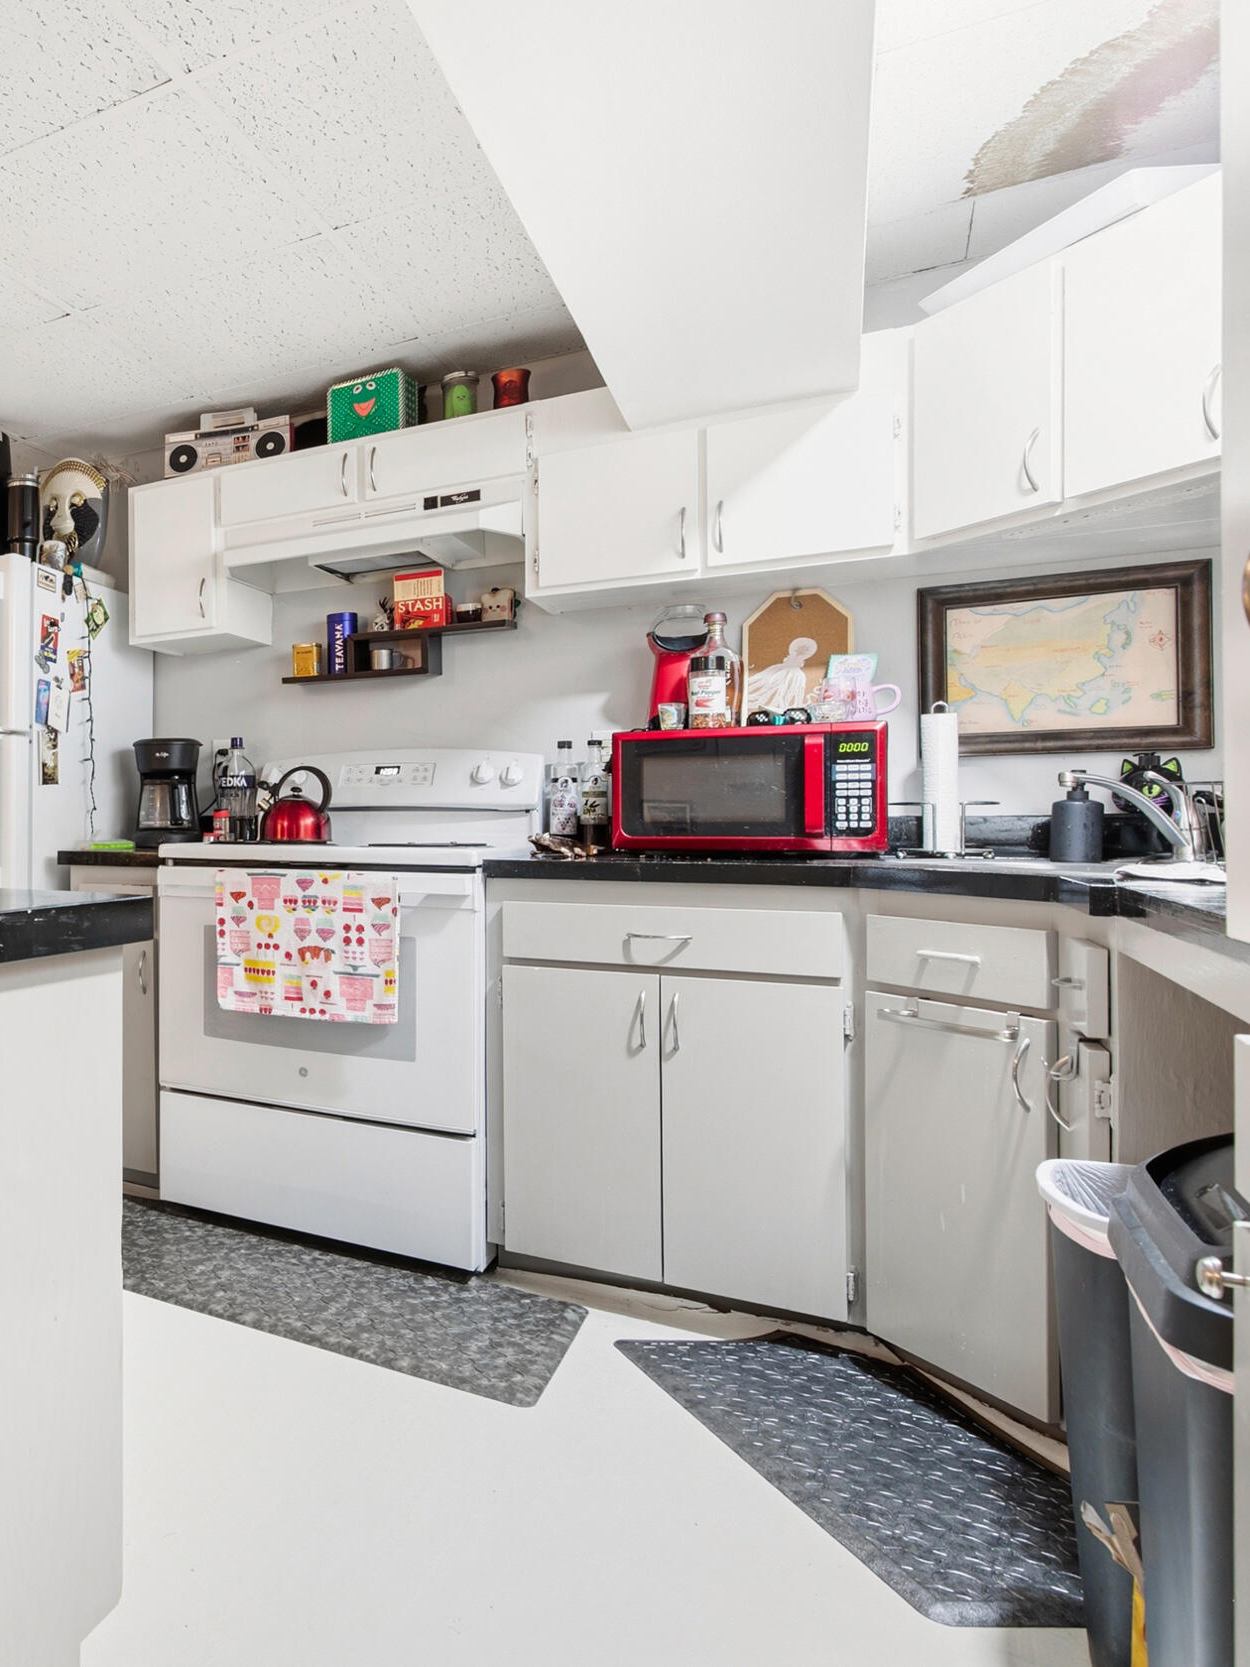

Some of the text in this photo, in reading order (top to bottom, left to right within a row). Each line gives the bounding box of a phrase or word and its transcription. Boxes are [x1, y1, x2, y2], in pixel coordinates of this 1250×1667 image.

[398, 598, 443, 613] STASH
[335, 624, 344, 672] TEAVANA
[839, 742, 869, 753] 0000
